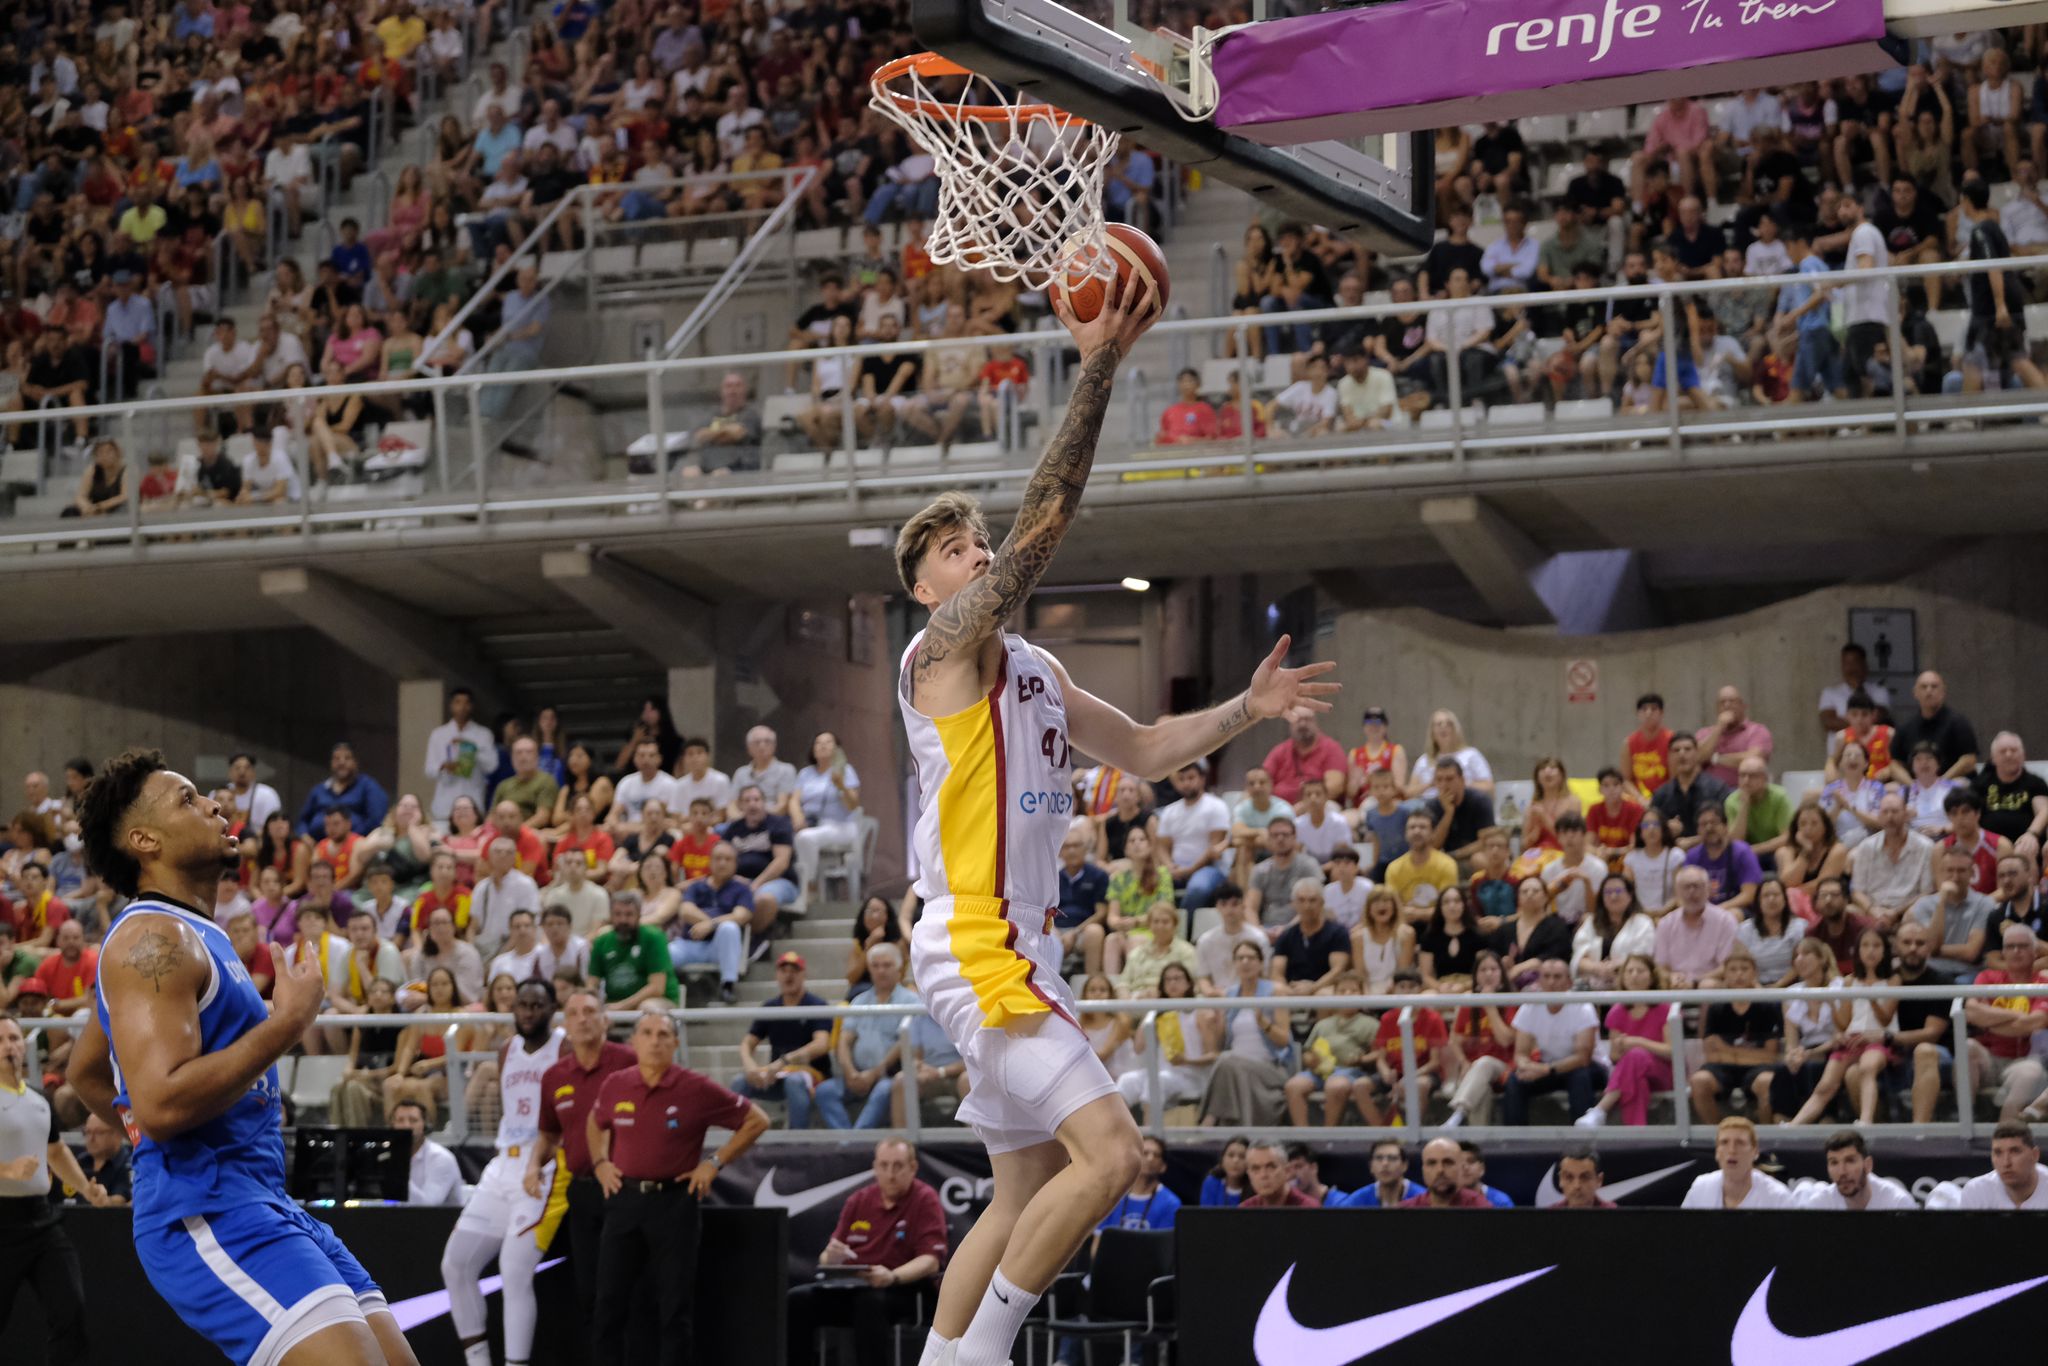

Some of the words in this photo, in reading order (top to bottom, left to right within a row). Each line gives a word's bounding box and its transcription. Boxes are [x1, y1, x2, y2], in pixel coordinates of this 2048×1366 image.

[1486, 0, 1661, 62] renfe
[1681, 0, 1723, 34] Tu
[1738, 0, 1837, 26] tren
